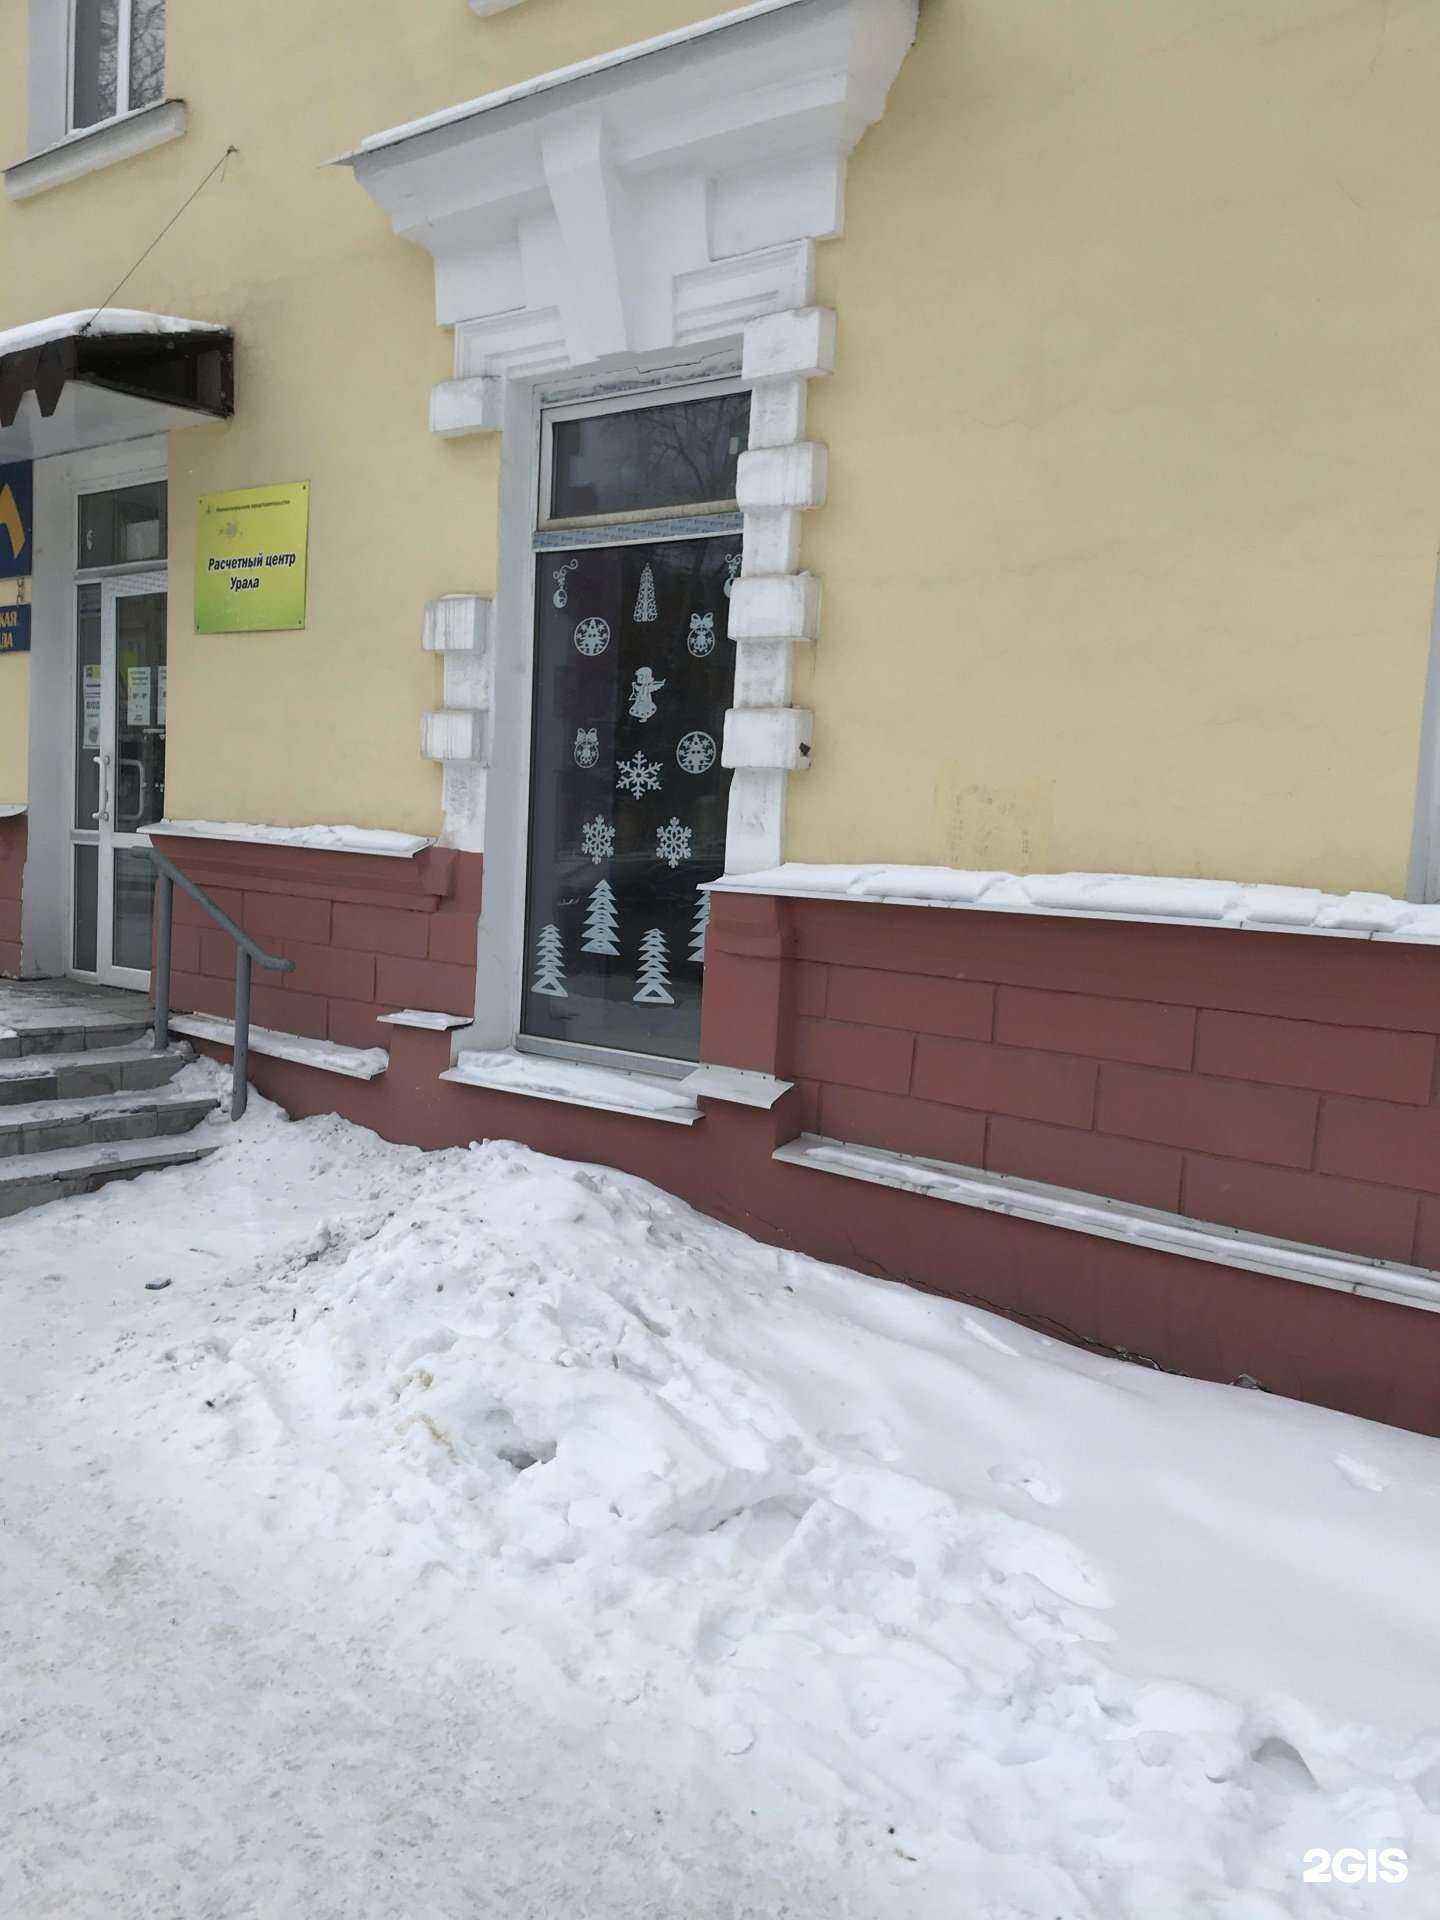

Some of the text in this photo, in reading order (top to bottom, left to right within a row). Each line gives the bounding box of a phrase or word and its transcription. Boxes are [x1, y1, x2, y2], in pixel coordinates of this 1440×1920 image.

[208, 552, 296, 571] Расчетный центр
[230, 576, 259, 593] Урала
